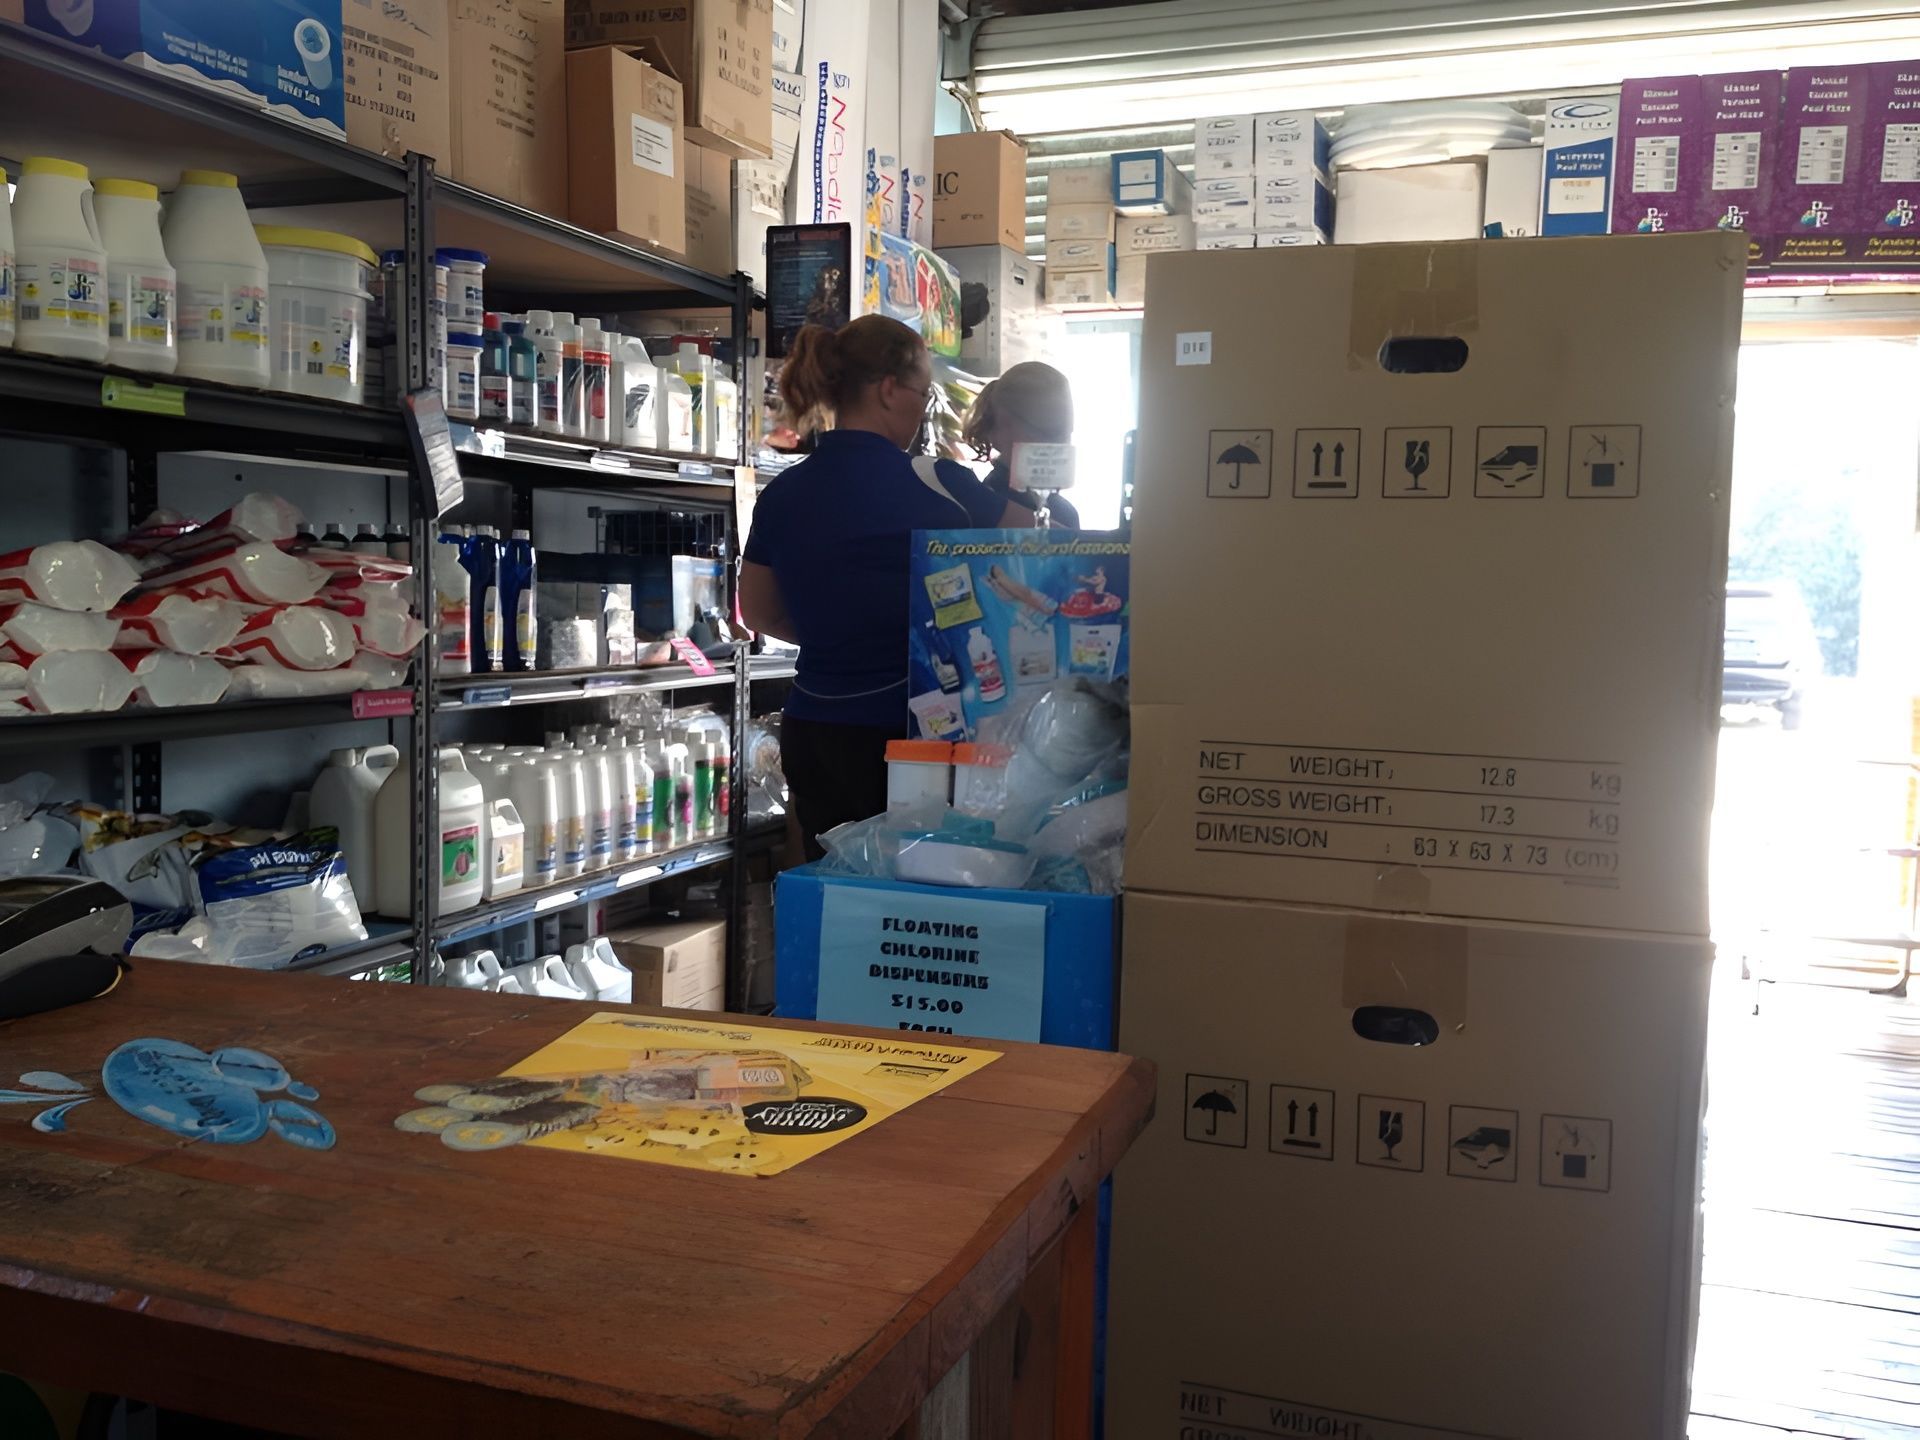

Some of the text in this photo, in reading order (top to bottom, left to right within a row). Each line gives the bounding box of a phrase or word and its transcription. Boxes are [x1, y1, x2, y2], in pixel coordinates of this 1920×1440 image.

[1200, 750, 1246, 771] NET
[1479, 766, 1517, 788] 12.8
[1590, 770, 1622, 797] kg
[1197, 785, 1282, 810] GROSS
[1479, 804, 1516, 827] 17.3
[1588, 809, 1620, 836] kg
[1194, 820, 1329, 850] DIMENSION
[1413, 837, 1438, 858] 63
[1468, 841, 1492, 862] 63
[1525, 845, 1549, 866] 73
[1563, 847, 1620, 873] (cm)
[881, 916, 980, 940] FLOATING
[879, 941, 981, 965] CHLORINE
[868, 963, 990, 990] DISPENSERS
[890, 992, 964, 1015] $15.00
[1180, 1391, 1229, 1417] NET
